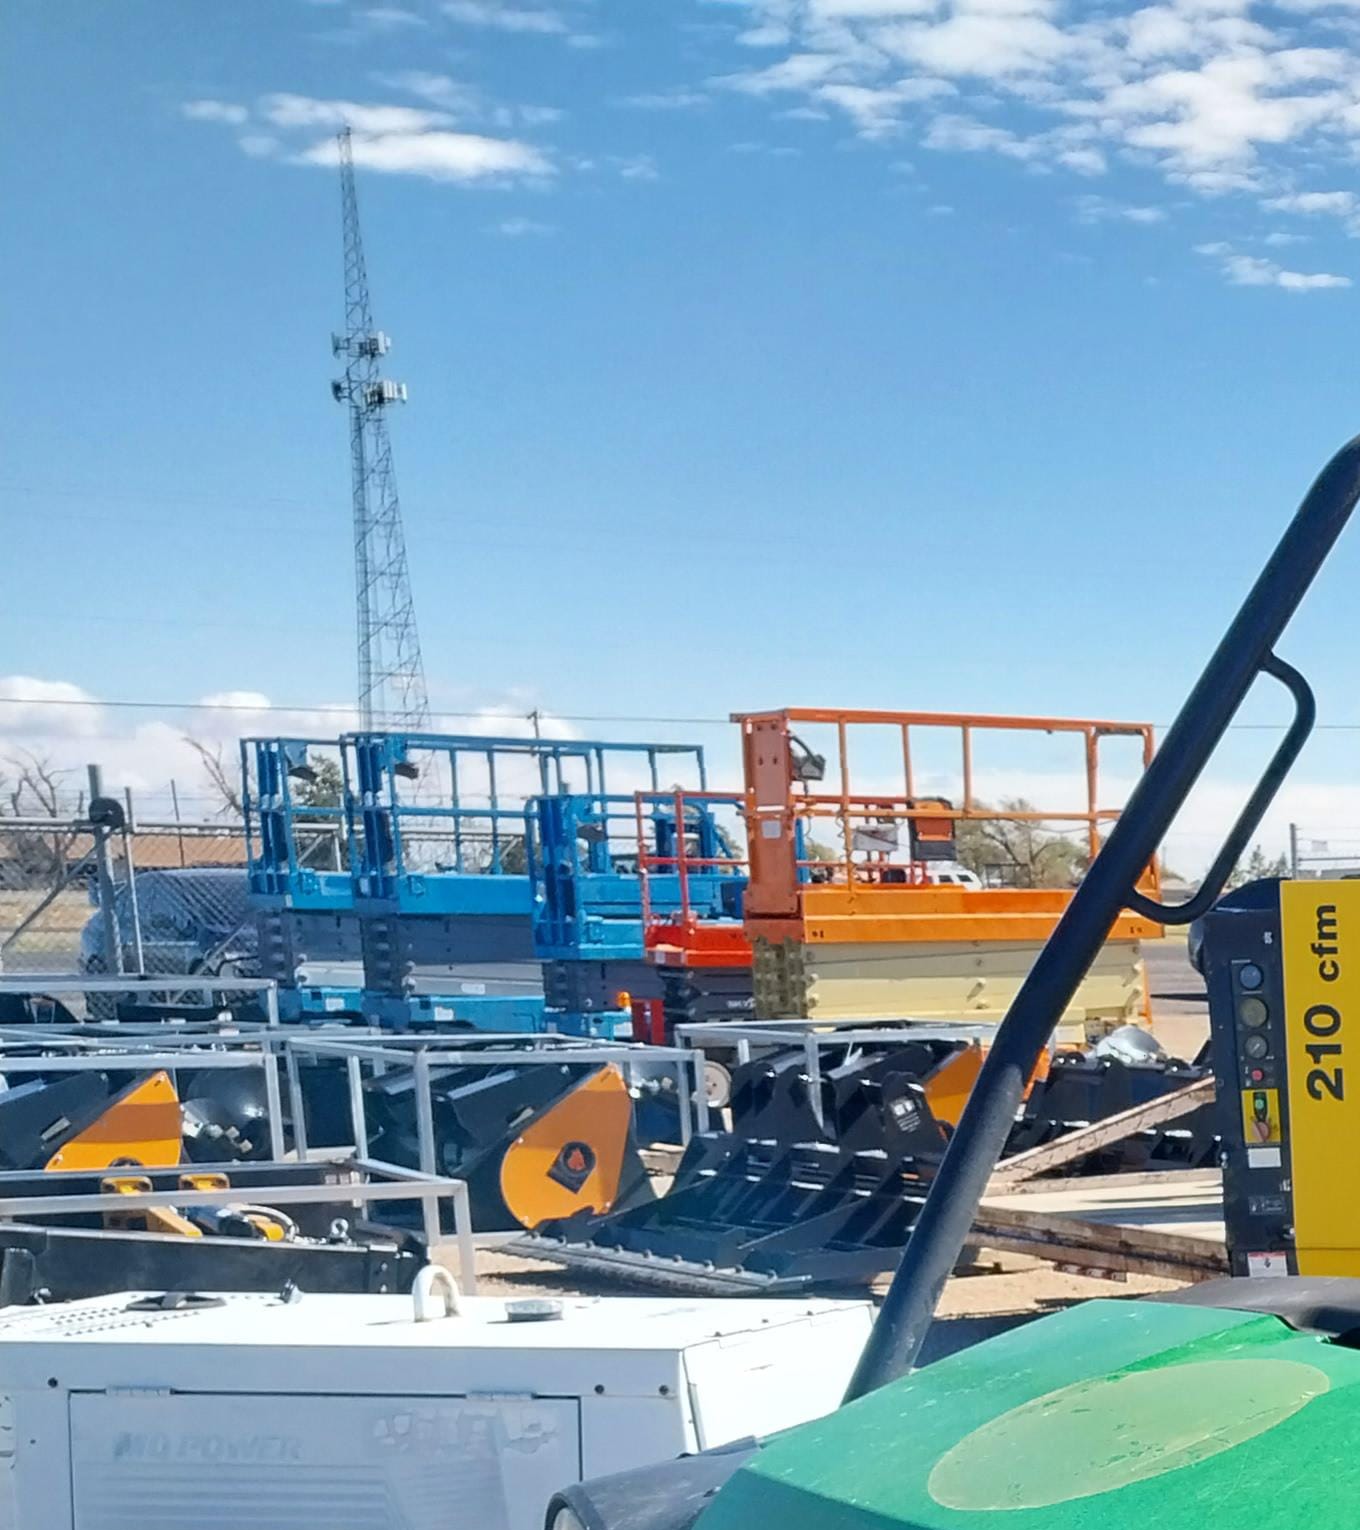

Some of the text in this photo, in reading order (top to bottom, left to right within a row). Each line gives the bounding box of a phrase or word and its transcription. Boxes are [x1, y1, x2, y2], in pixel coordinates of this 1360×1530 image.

[1304, 904, 1344, 1101] 210 cfm
[176, 1433, 304, 1461] POWER
